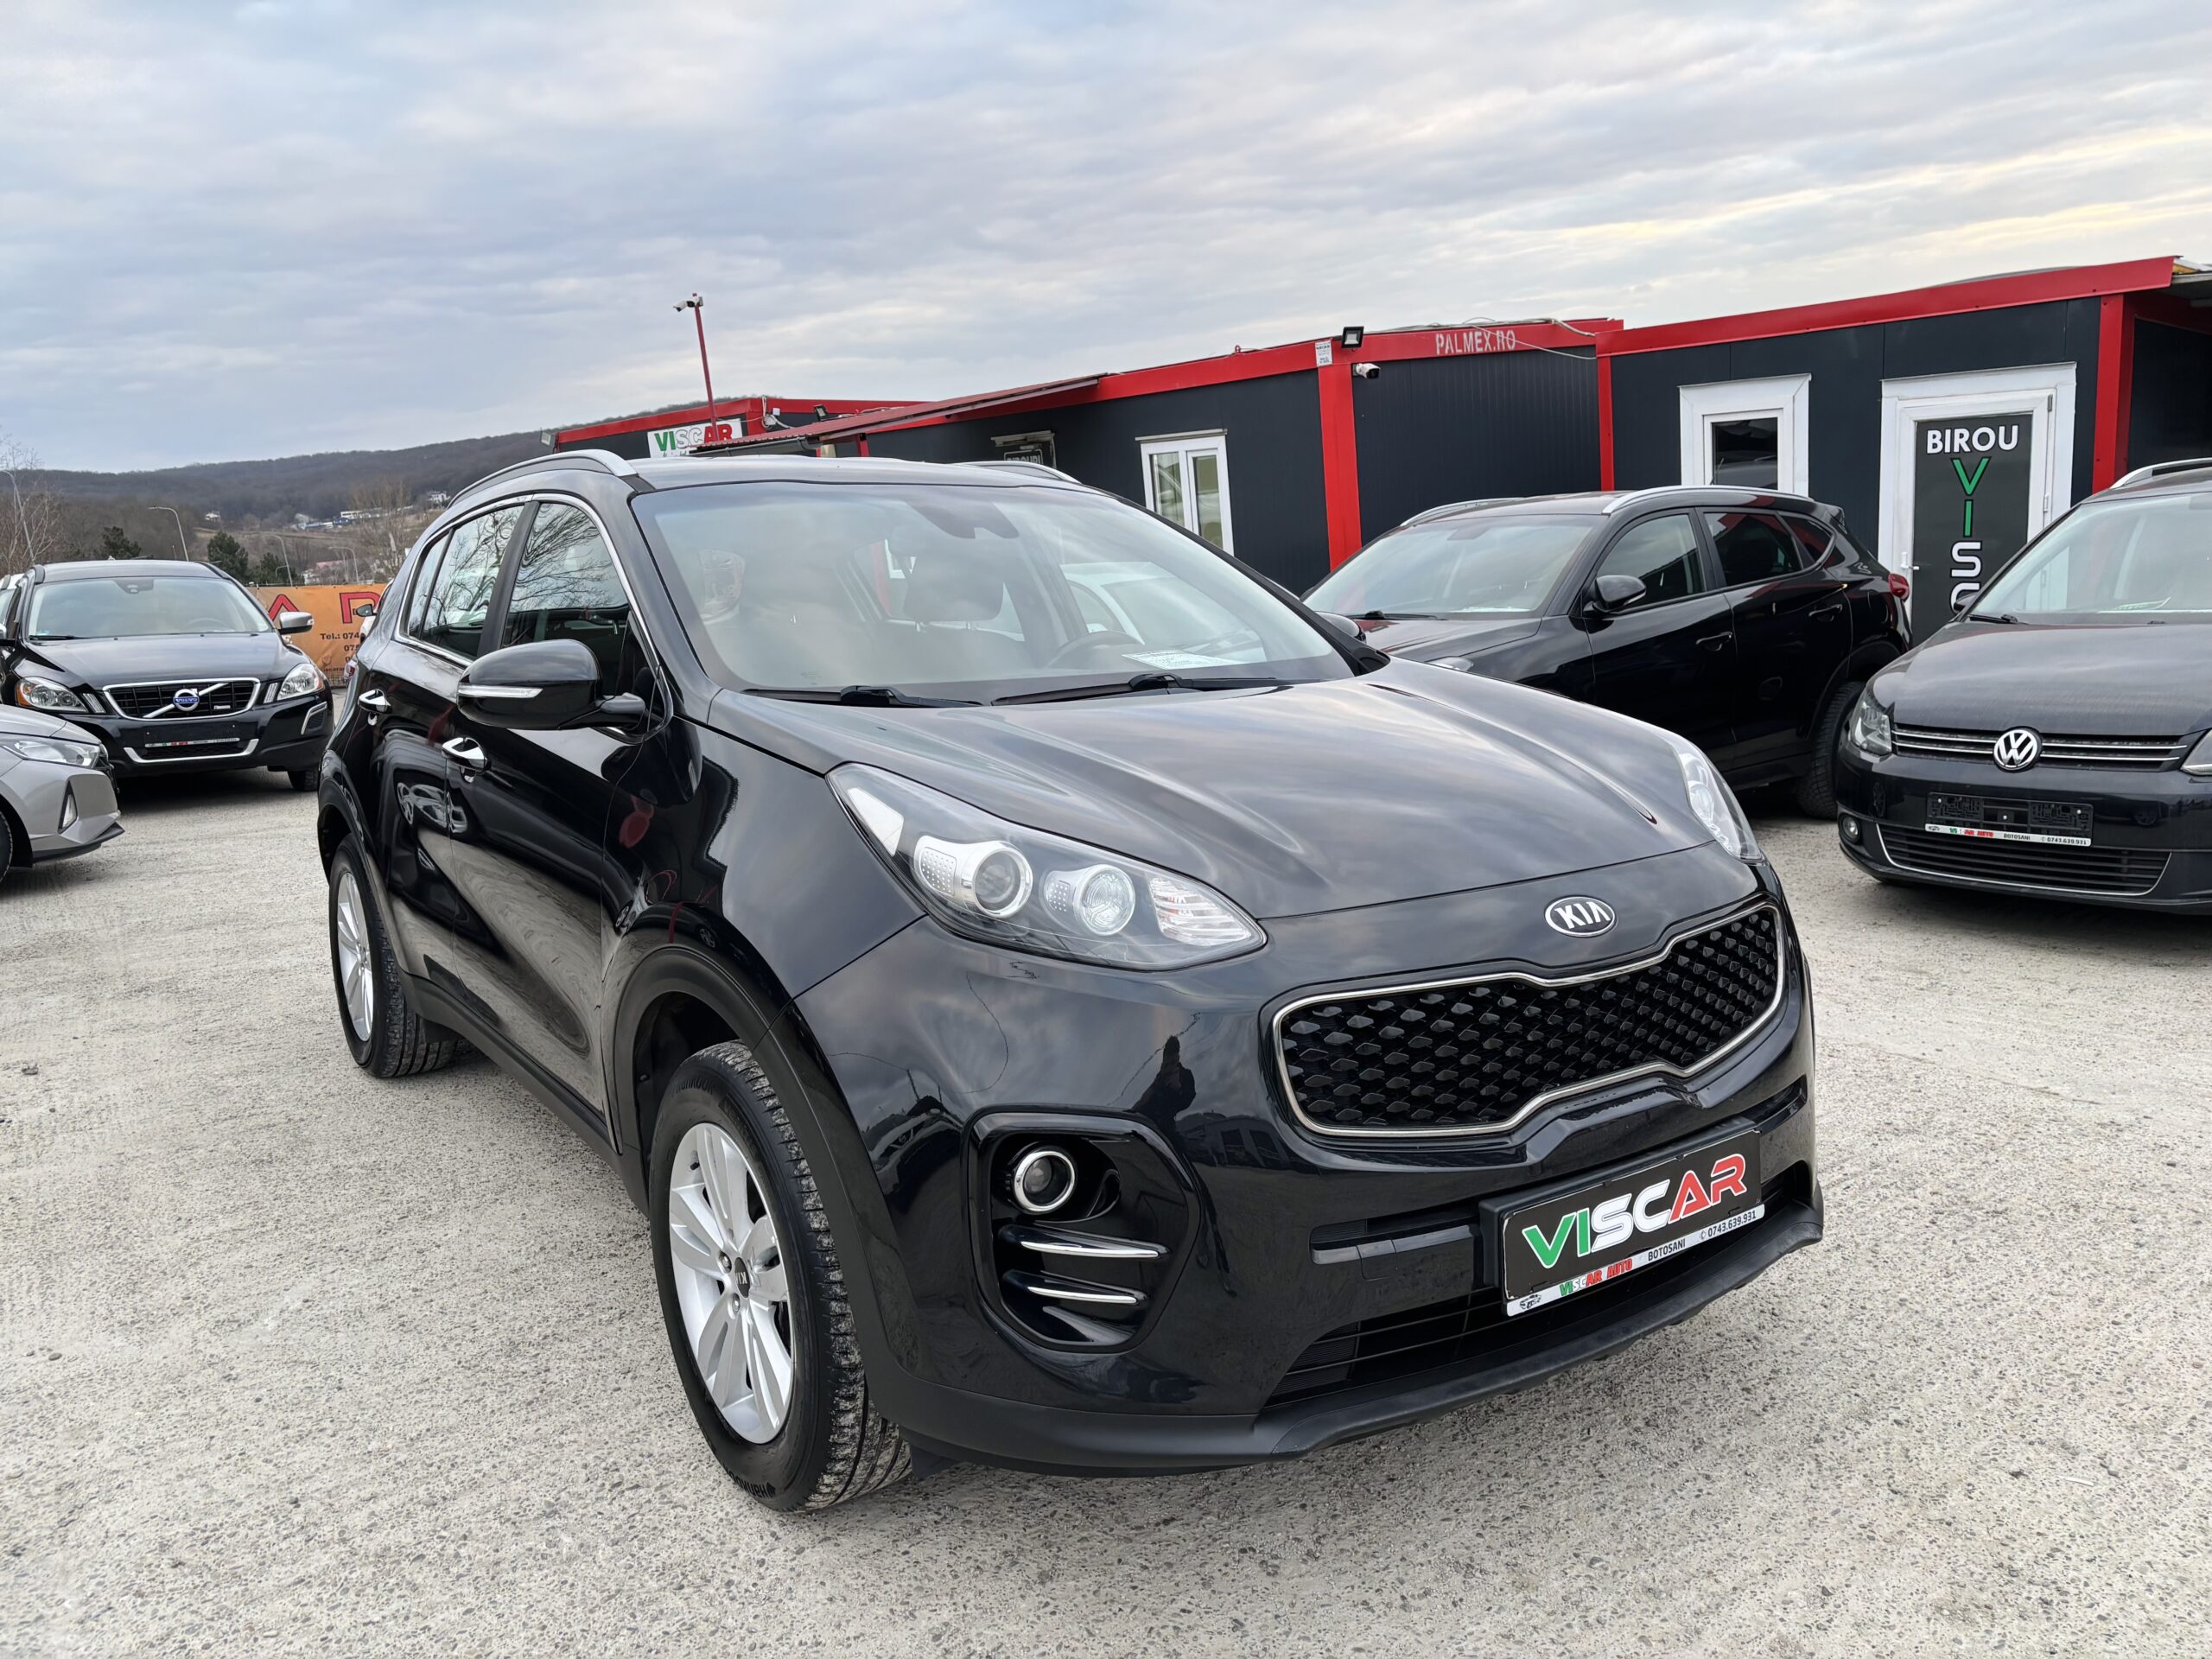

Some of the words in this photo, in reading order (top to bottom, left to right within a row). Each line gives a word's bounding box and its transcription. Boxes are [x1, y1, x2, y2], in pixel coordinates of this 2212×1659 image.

[1435, 329, 1516, 355] PALMEX.RO
[654, 423, 733, 452] VISCAR
[1926, 424, 2018, 454] BIROU
[1554, 901, 1611, 930] KIA
[1522, 1154, 1747, 1269] VISCAR
[1560, 1270, 1603, 1296] VISCAR
[1607, 1258, 1633, 1279] AUTO
[1648, 1239, 1686, 1261] BOTOSANI
[1707, 1211, 1757, 1237] 0743.639.931
